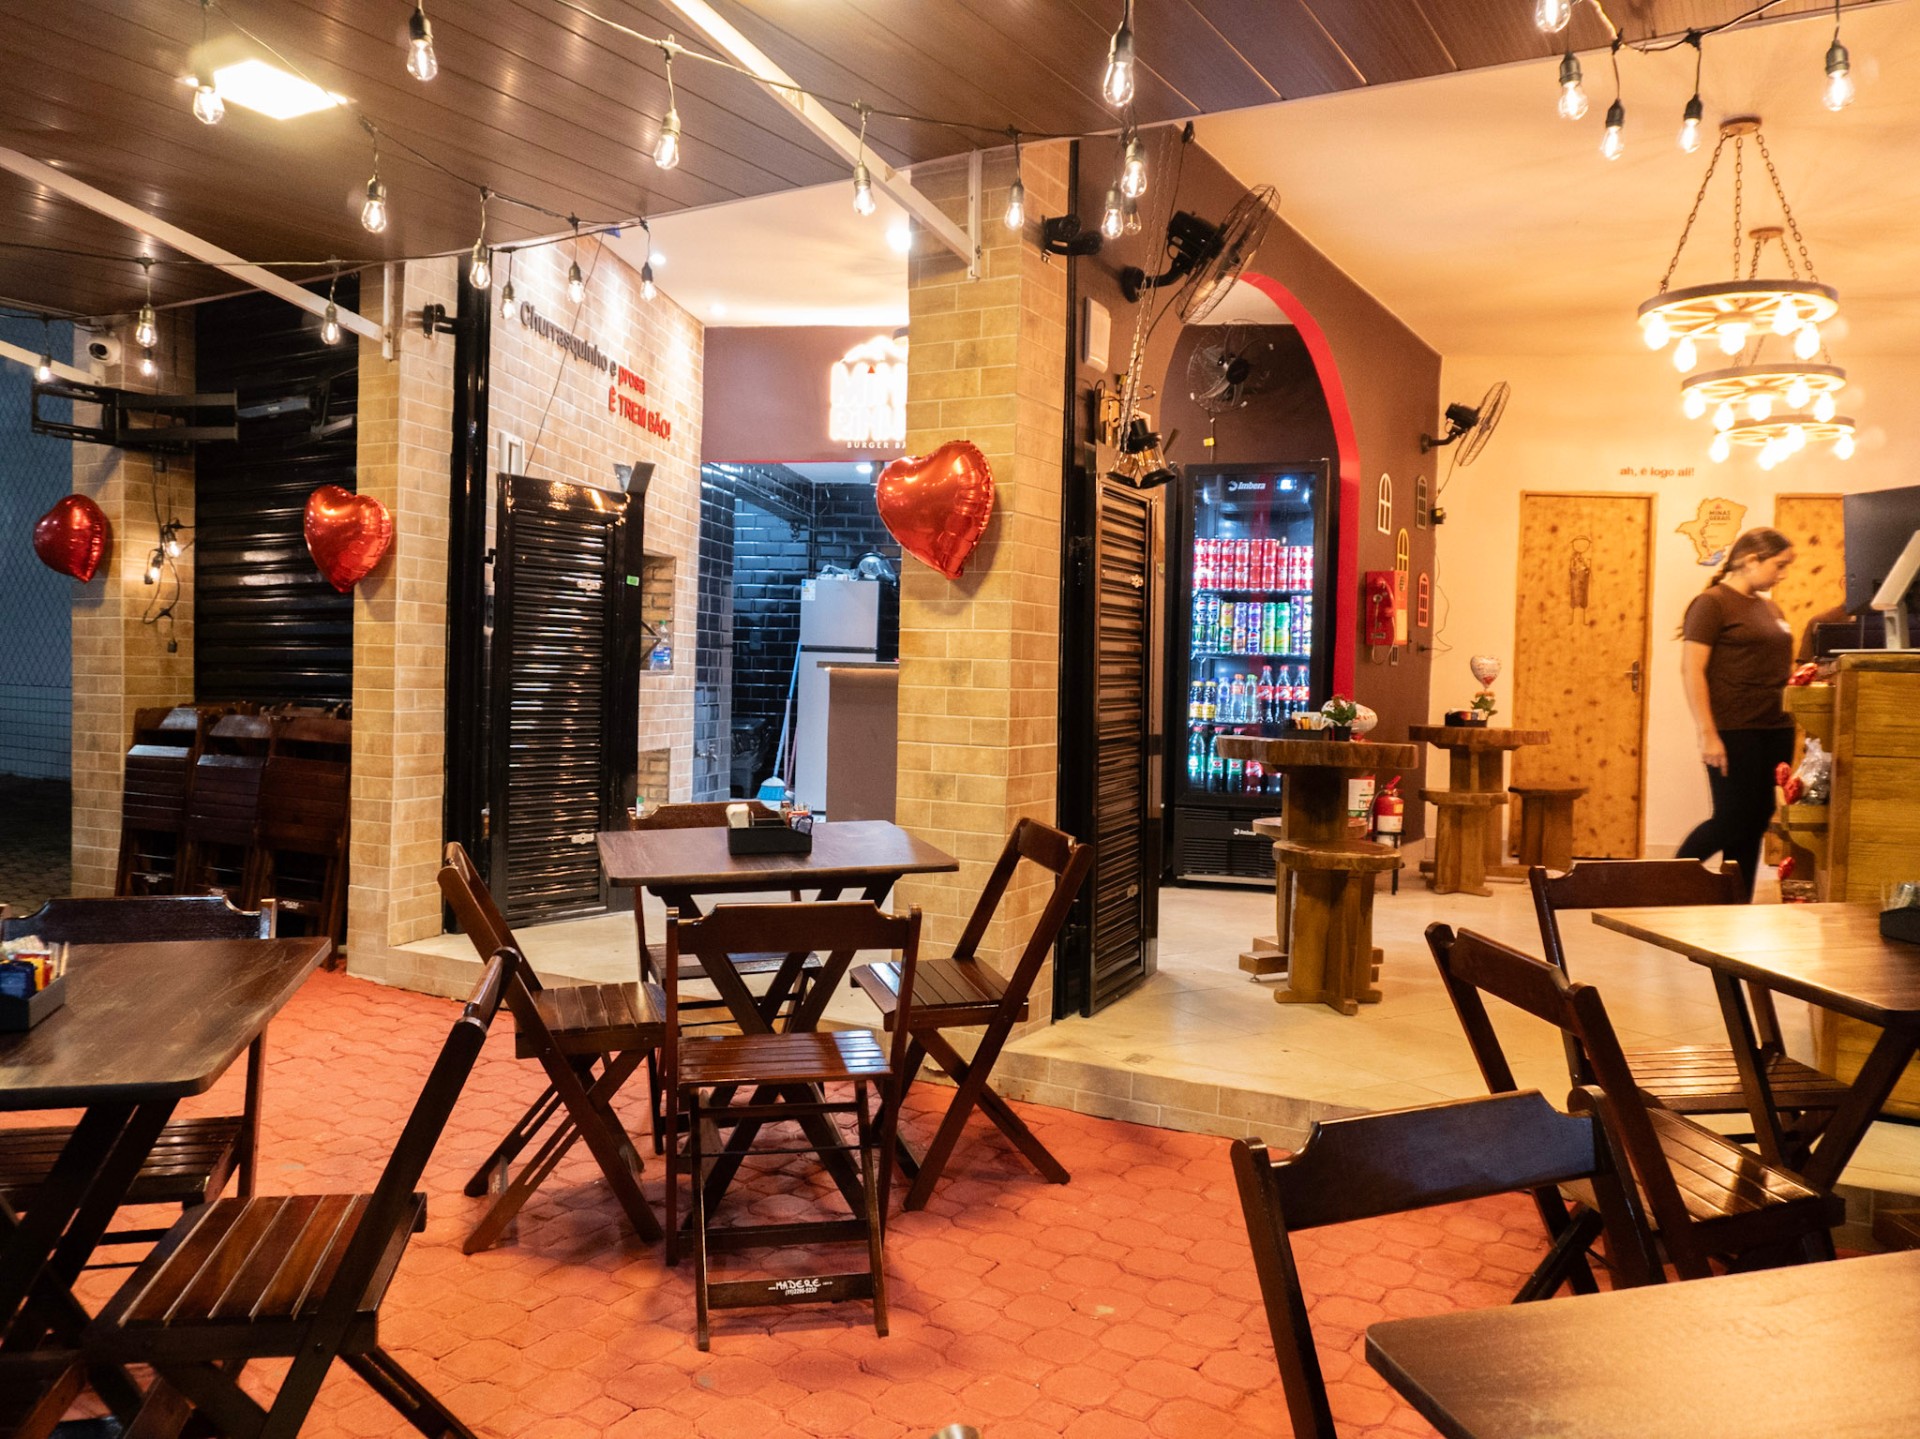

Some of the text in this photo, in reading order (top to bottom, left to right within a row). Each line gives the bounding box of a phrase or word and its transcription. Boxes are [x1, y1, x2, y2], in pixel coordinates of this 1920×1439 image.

[520, 301, 646, 395] Churrasquinho e prosa
[618, 394, 647, 429] TREM
[647, 410, 671, 442] BÃO!
[846, 441, 889, 449] BURGER
[1650, 466, 1675, 478] logo
